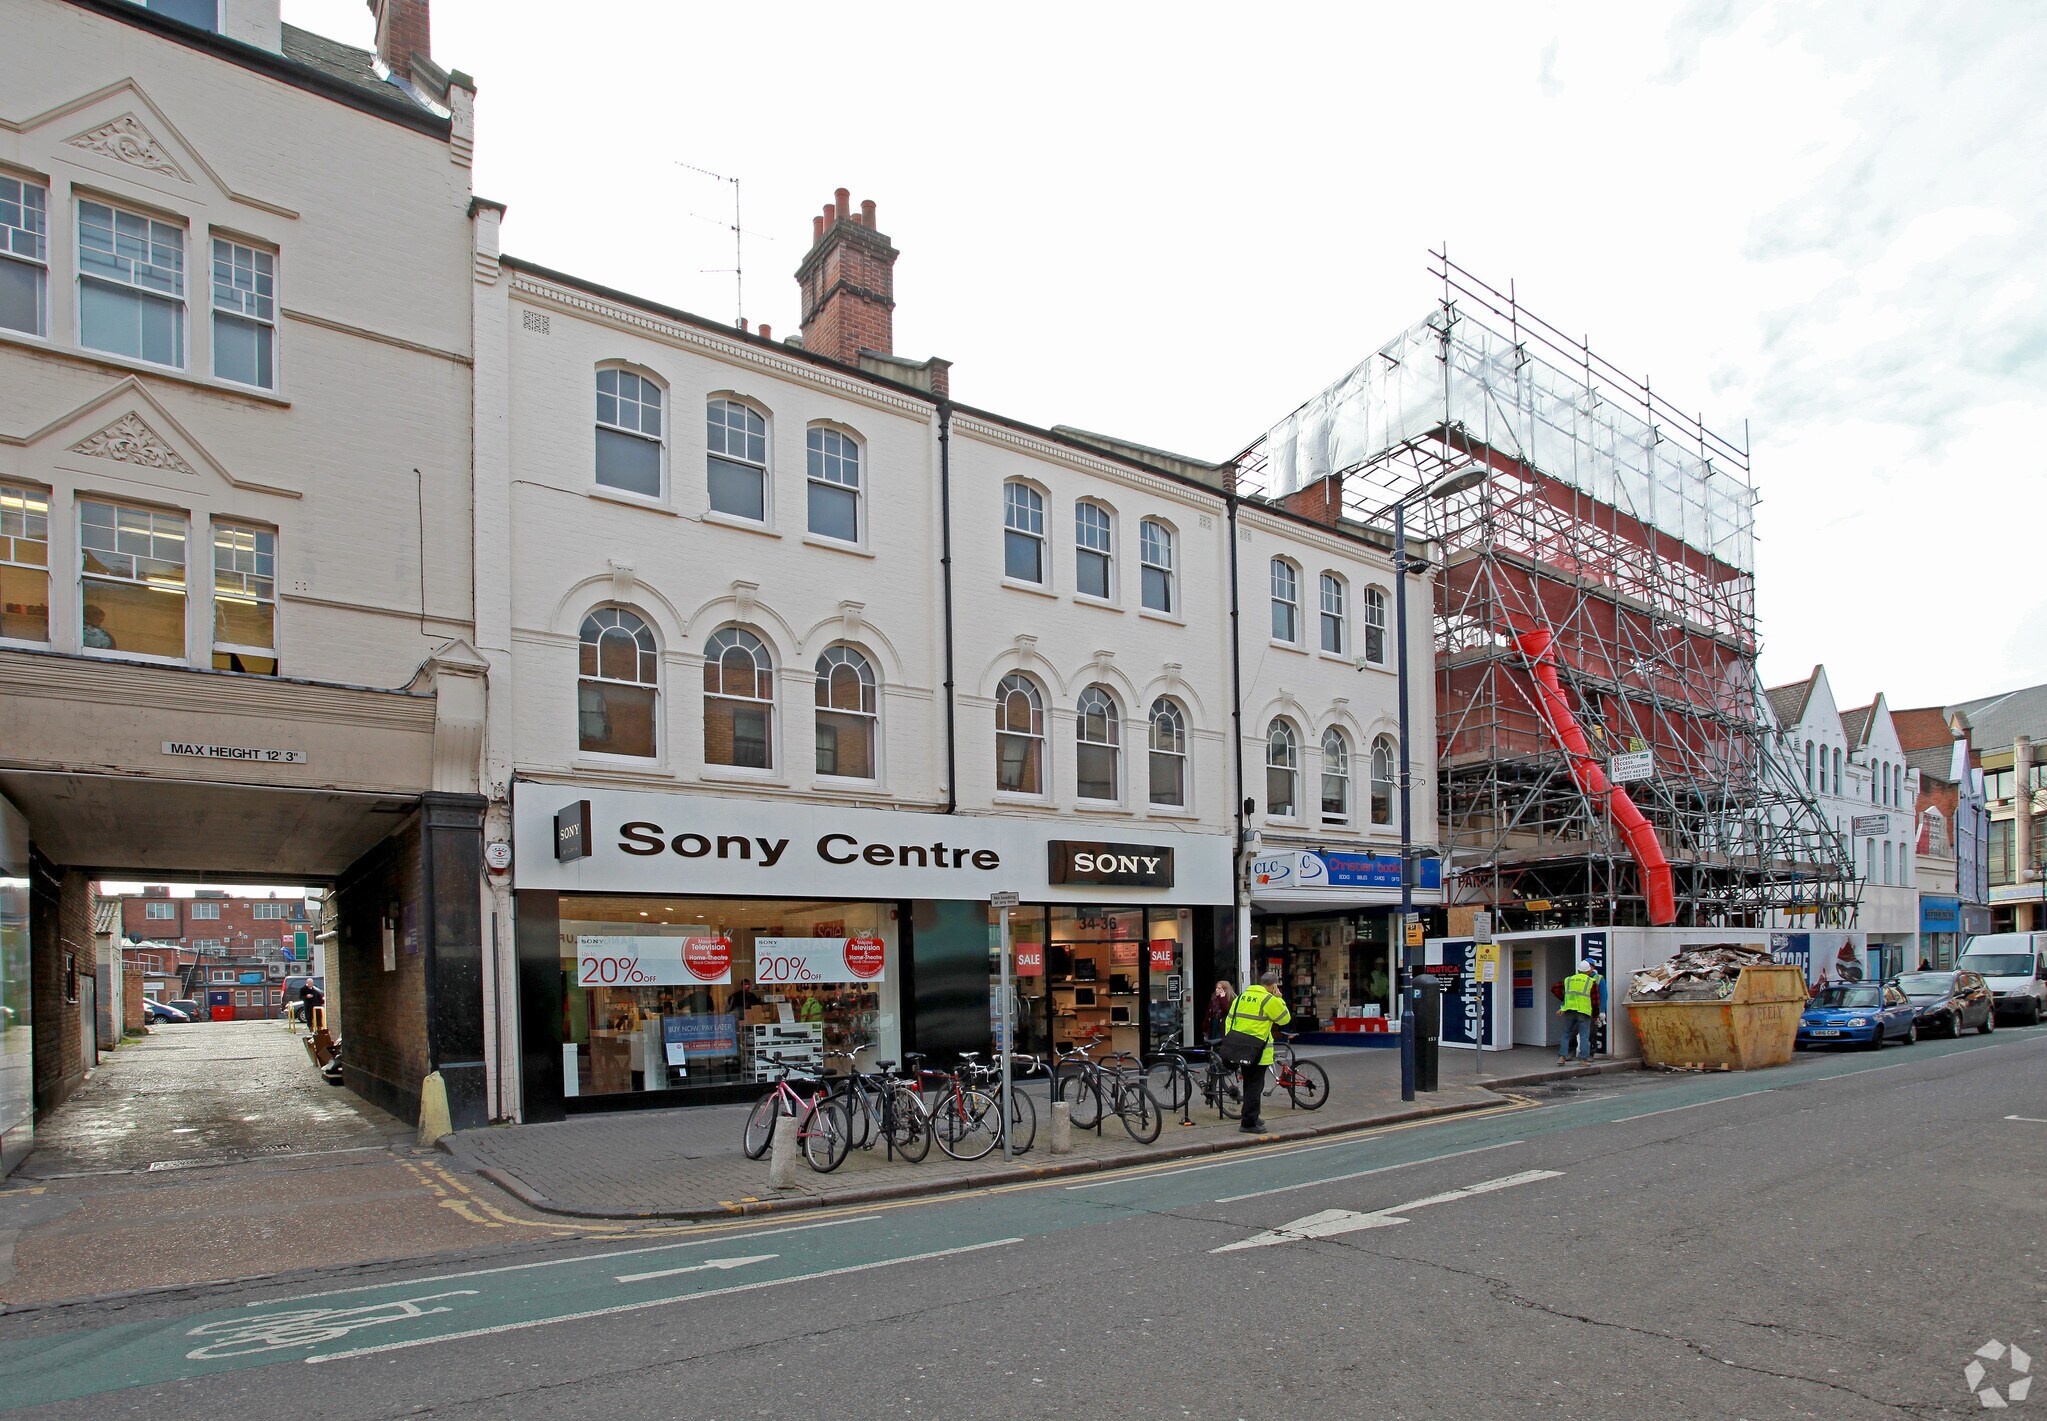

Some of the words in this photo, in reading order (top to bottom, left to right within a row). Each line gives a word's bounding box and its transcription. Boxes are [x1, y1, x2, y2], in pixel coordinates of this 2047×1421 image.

[171, 743, 204, 755] MAX
[209, 746, 261, 759] HEIGHT
[560, 823, 580, 840] SONY
[618, 821, 790, 867] Sony
[816, 833, 1000, 870] Centre
[1074, 852, 1160, 874] SONY
[1254, 860, 1278, 874] CLC
[1329, 858, 1374, 873] Christian
[1079, 917, 1117, 930] 34-36
[1018, 954, 1040, 965] SALE
[1152, 951, 1171, 961] SALE
[581, 957, 643, 983] 20%
[759, 957, 811, 980] 20%
[1414, 989, 1421, 998] P
